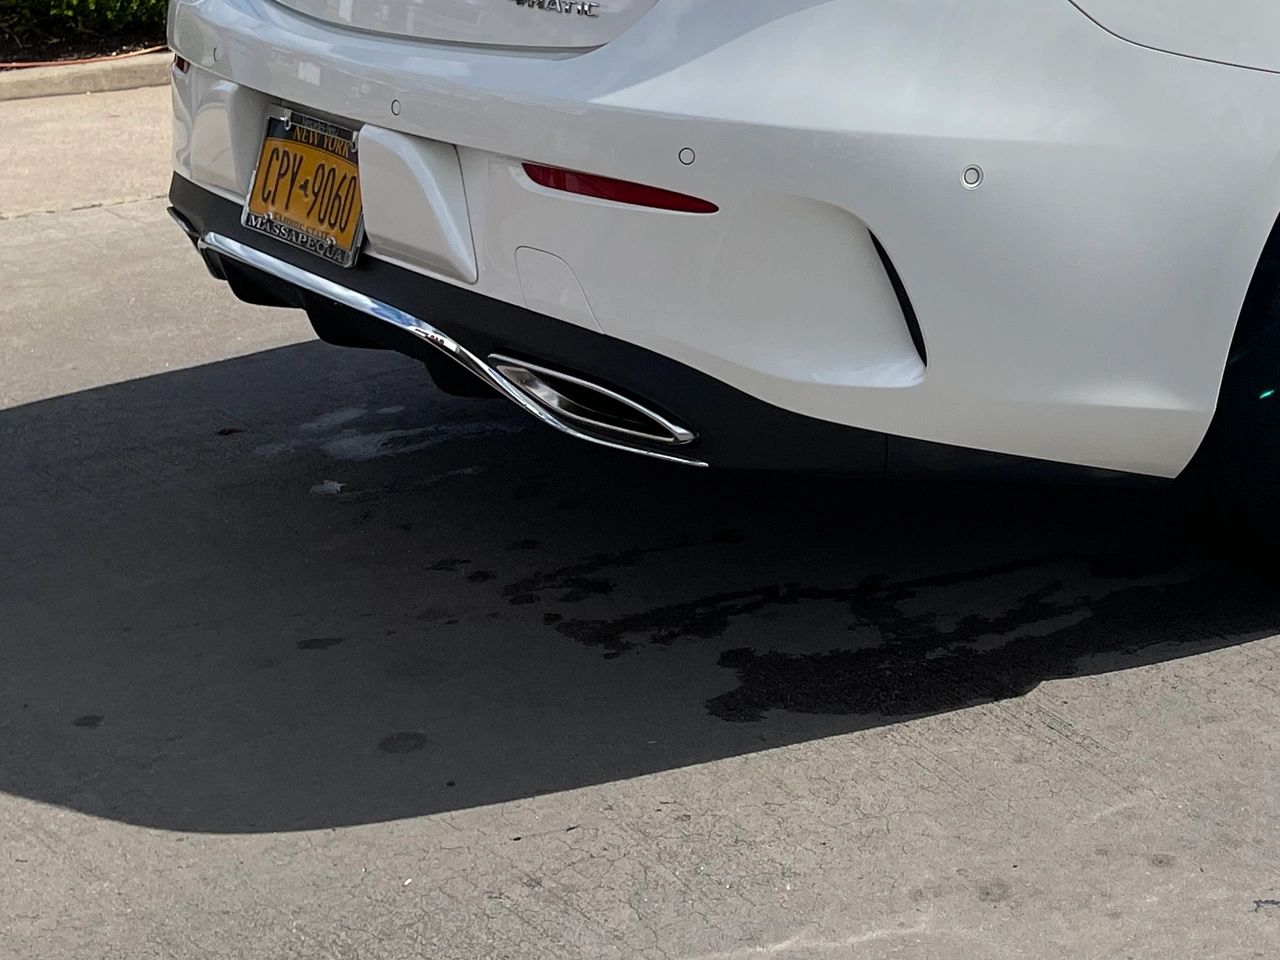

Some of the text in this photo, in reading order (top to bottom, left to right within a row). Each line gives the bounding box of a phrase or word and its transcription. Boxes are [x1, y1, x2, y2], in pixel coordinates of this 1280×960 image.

[293, 126, 350, 157] NEW YORK
[262, 147, 357, 233] CPY 9060
[248, 215, 344, 261] MASSAPEQUA
